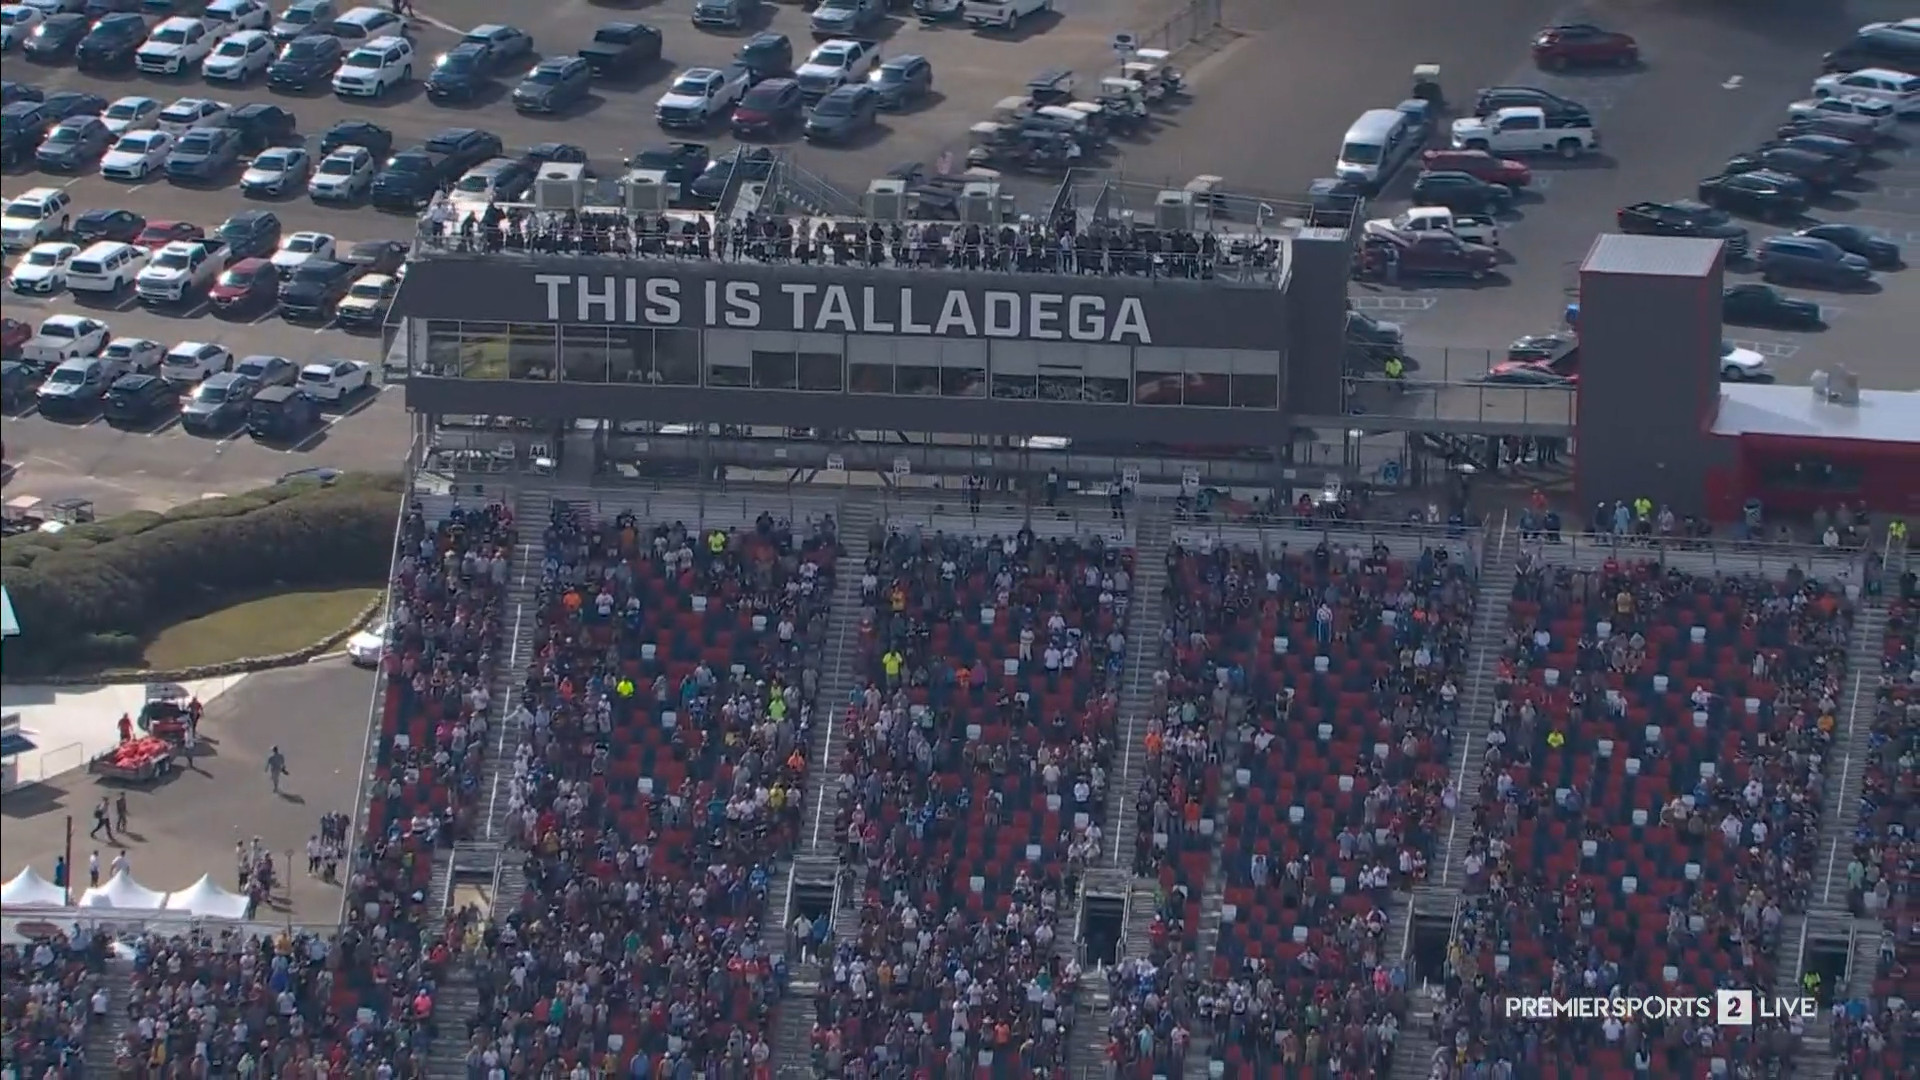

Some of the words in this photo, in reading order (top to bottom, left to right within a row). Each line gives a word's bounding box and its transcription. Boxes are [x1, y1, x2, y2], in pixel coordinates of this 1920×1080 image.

[535, 274, 681, 324] THIS
[705, 280, 760, 327] IS
[781, 284, 1152, 344] TALLADEGA
